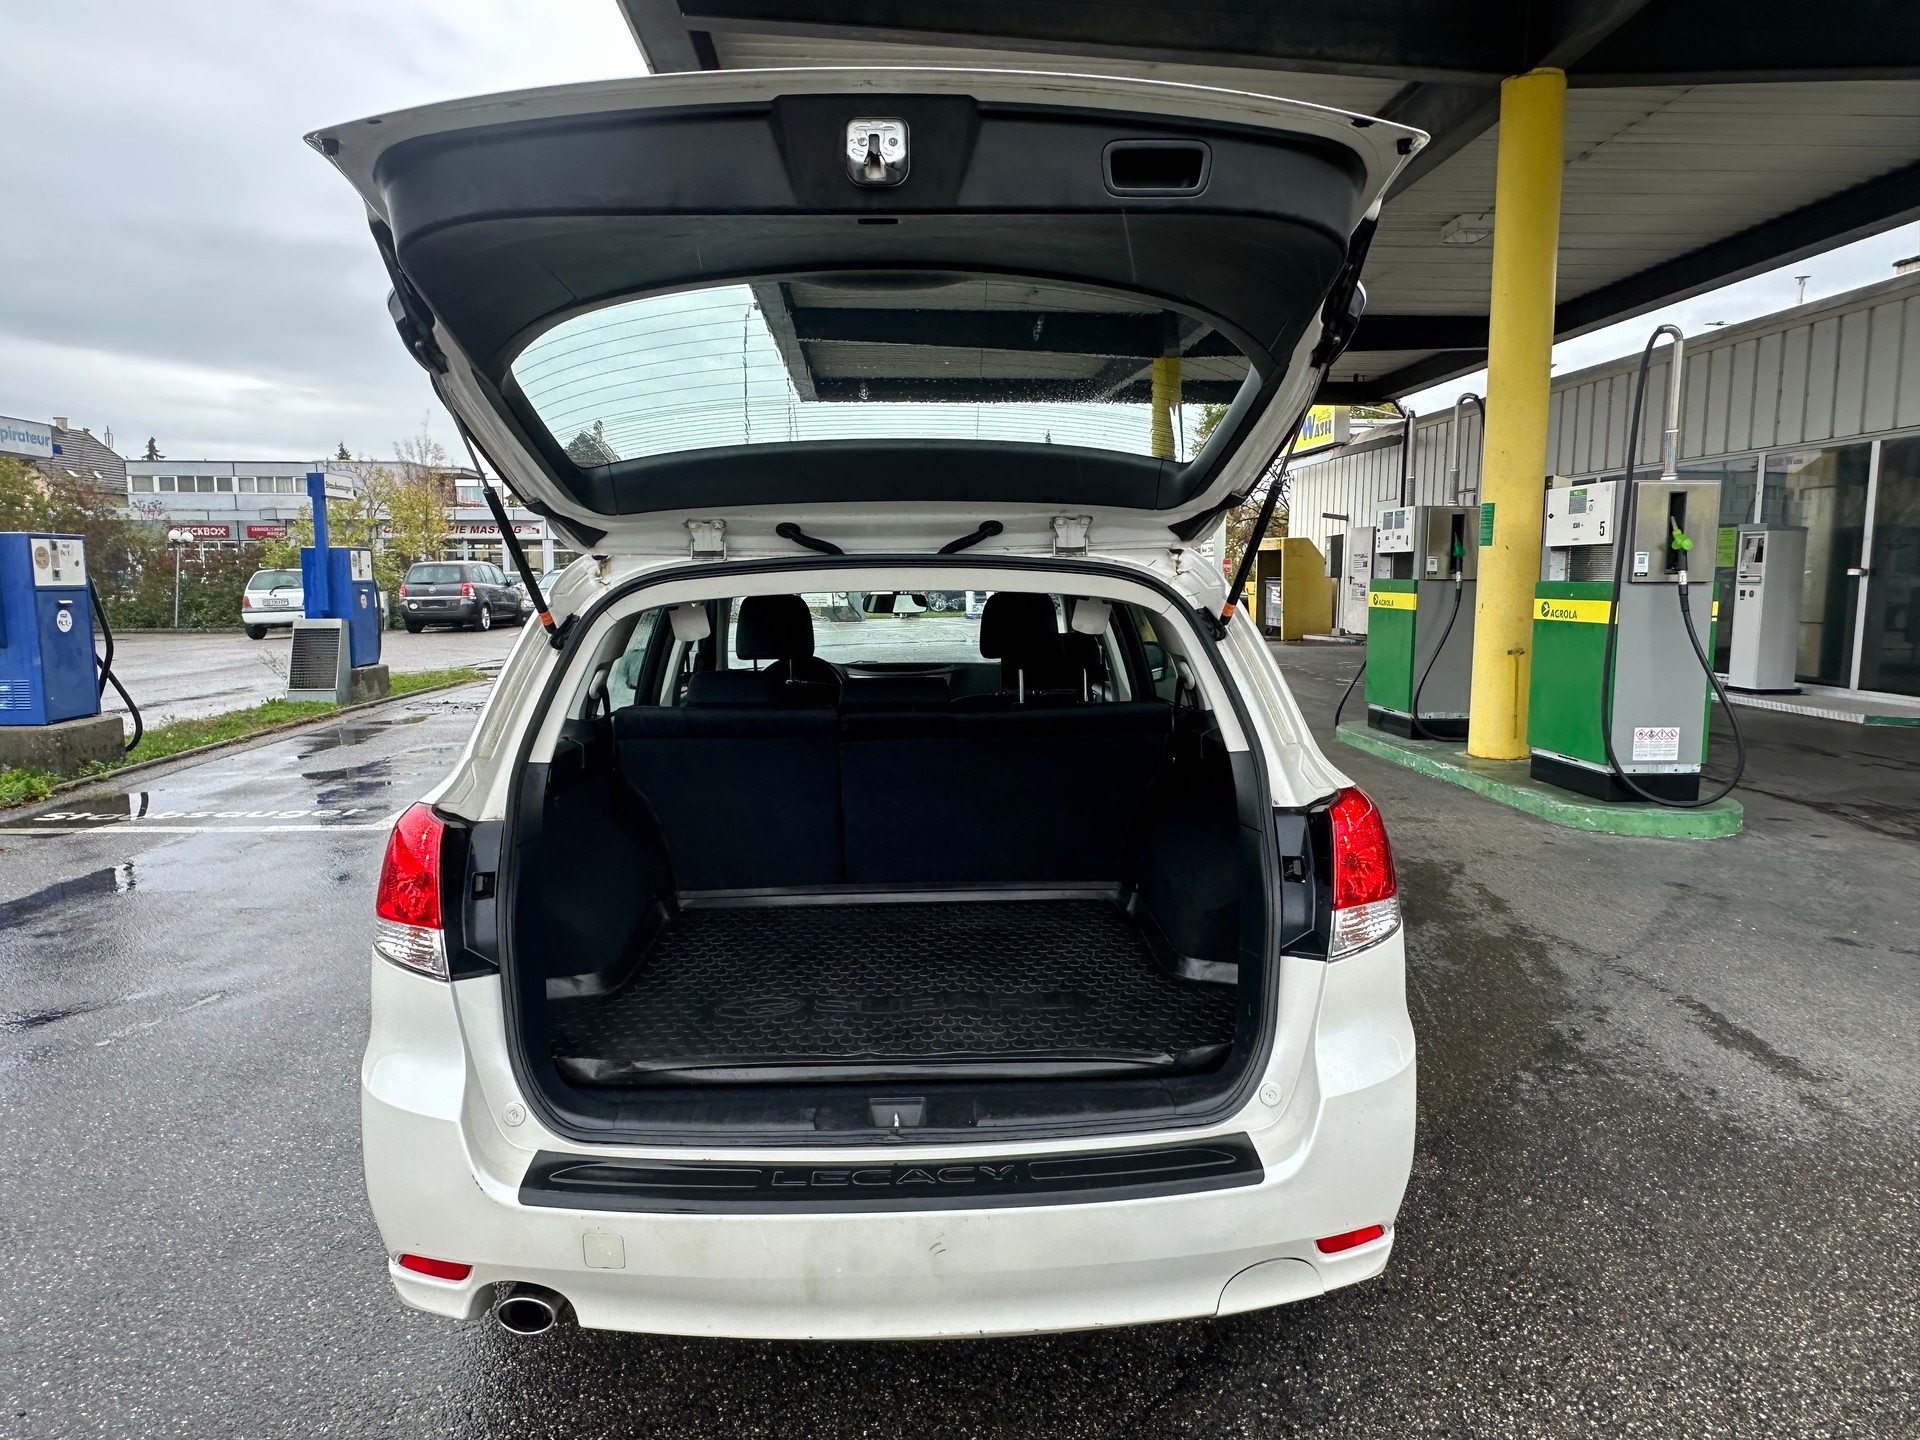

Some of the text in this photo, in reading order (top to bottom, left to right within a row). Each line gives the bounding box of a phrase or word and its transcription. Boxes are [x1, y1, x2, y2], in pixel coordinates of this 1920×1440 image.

[0, 426, 50, 447] pirateur
[1303, 414, 1331, 441] WASH
[173, 527, 226, 536] HECKBOX
[1599, 521, 1605, 536] 5
[1550, 609, 1578, 620] AGROLA
[772, 1165, 1015, 1187] LEGACY
